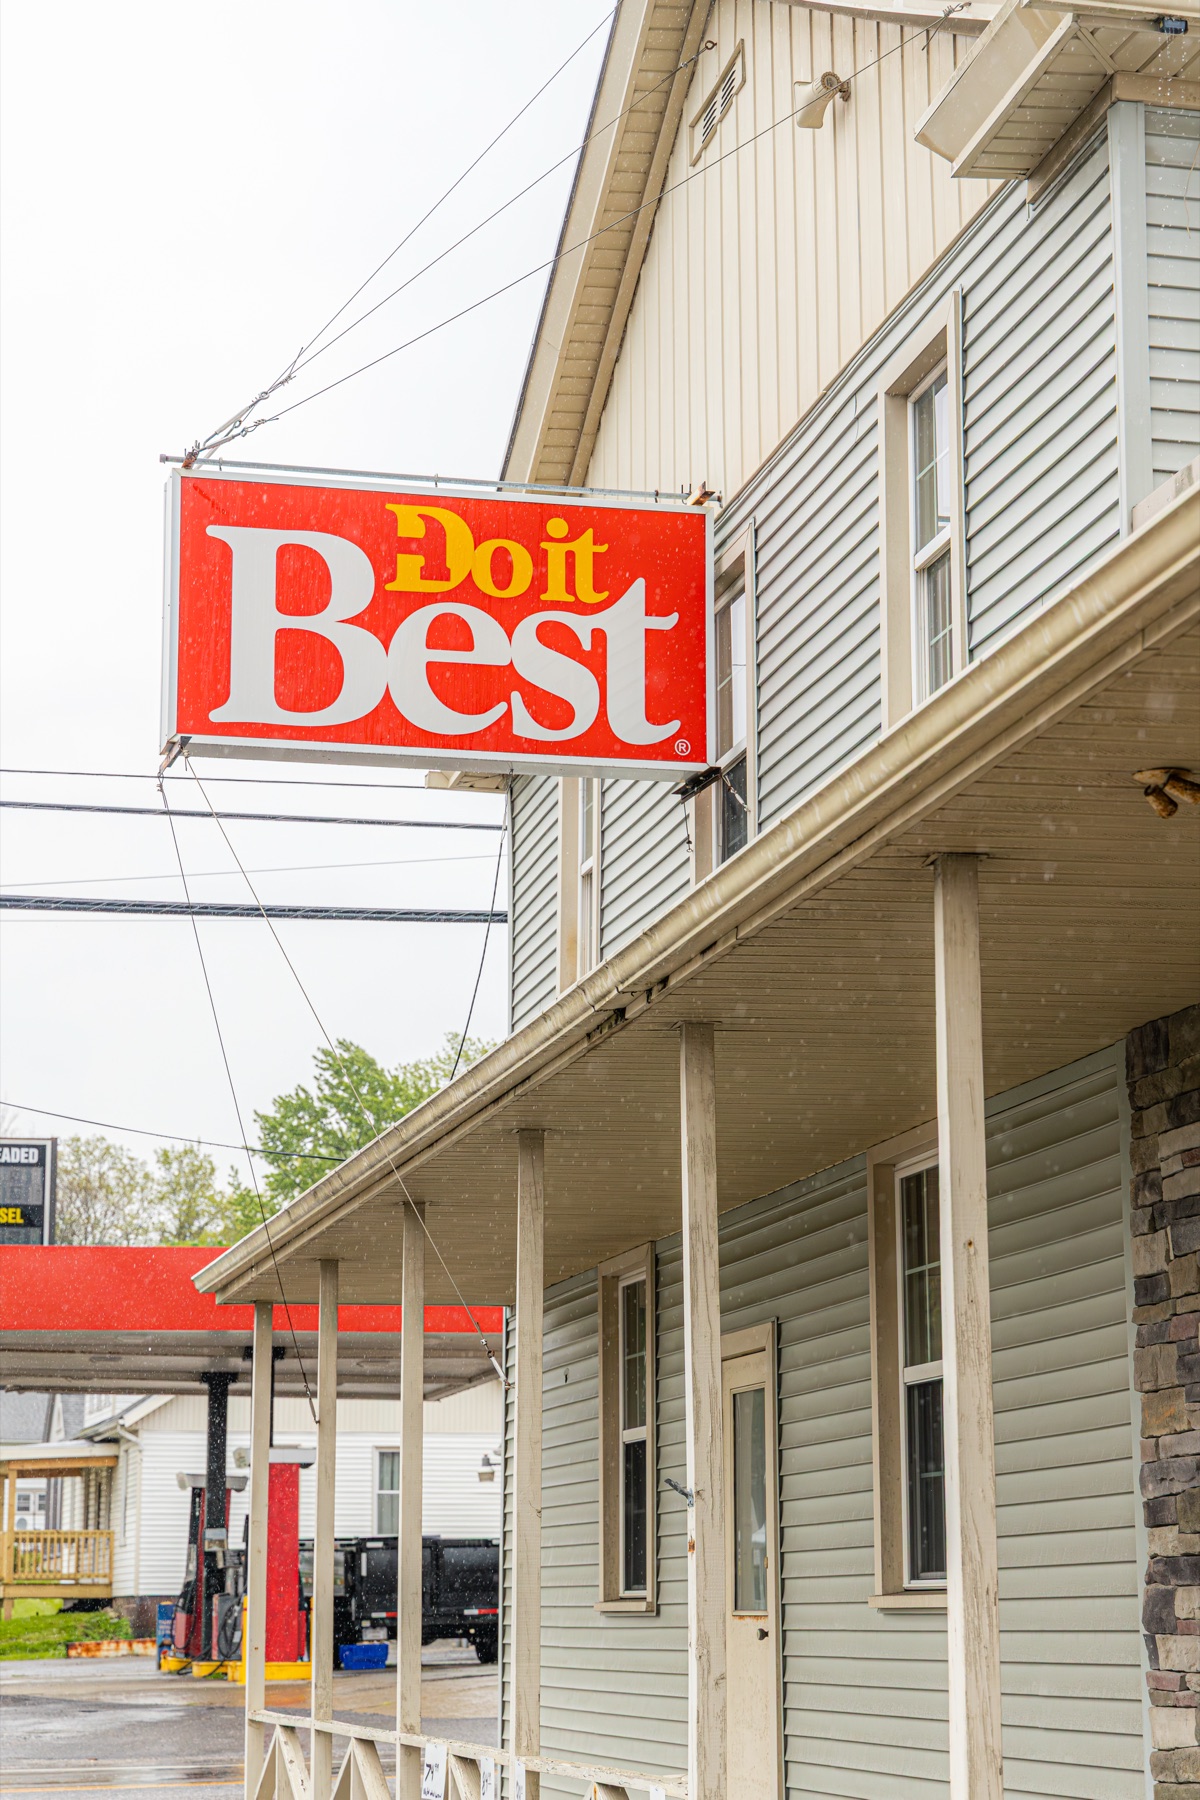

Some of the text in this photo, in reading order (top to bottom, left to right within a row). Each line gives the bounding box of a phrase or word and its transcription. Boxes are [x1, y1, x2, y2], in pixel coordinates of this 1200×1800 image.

[384, 503, 609, 603] Do it
[206, 525, 681, 745] Best
[0, 1147, 39, 1163] ADED
